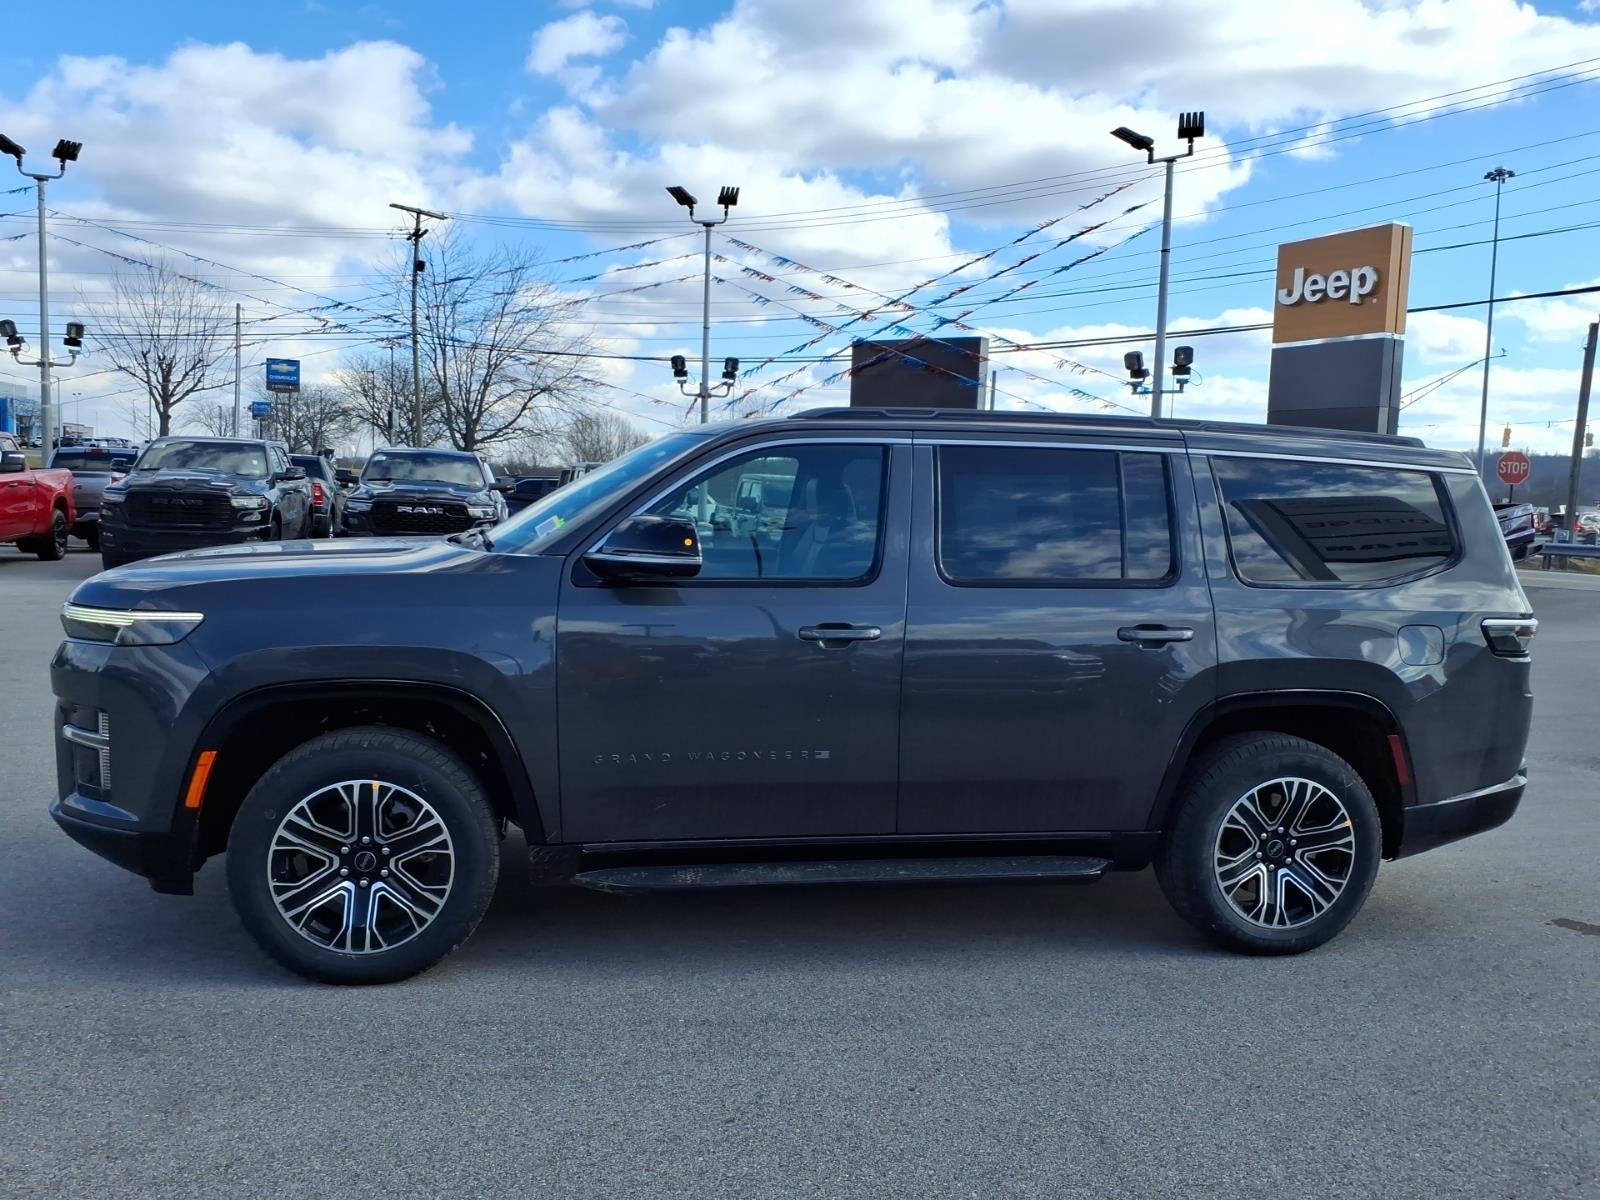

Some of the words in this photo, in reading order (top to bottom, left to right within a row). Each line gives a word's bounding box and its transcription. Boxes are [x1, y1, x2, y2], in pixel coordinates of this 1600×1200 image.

[1278, 265, 1378, 305] Jeep
[1499, 461, 1528, 474] STOP
[396, 505, 444, 514] RAM
[593, 752, 671, 764] GRAND
[687, 750, 809, 760] WAGONEER
